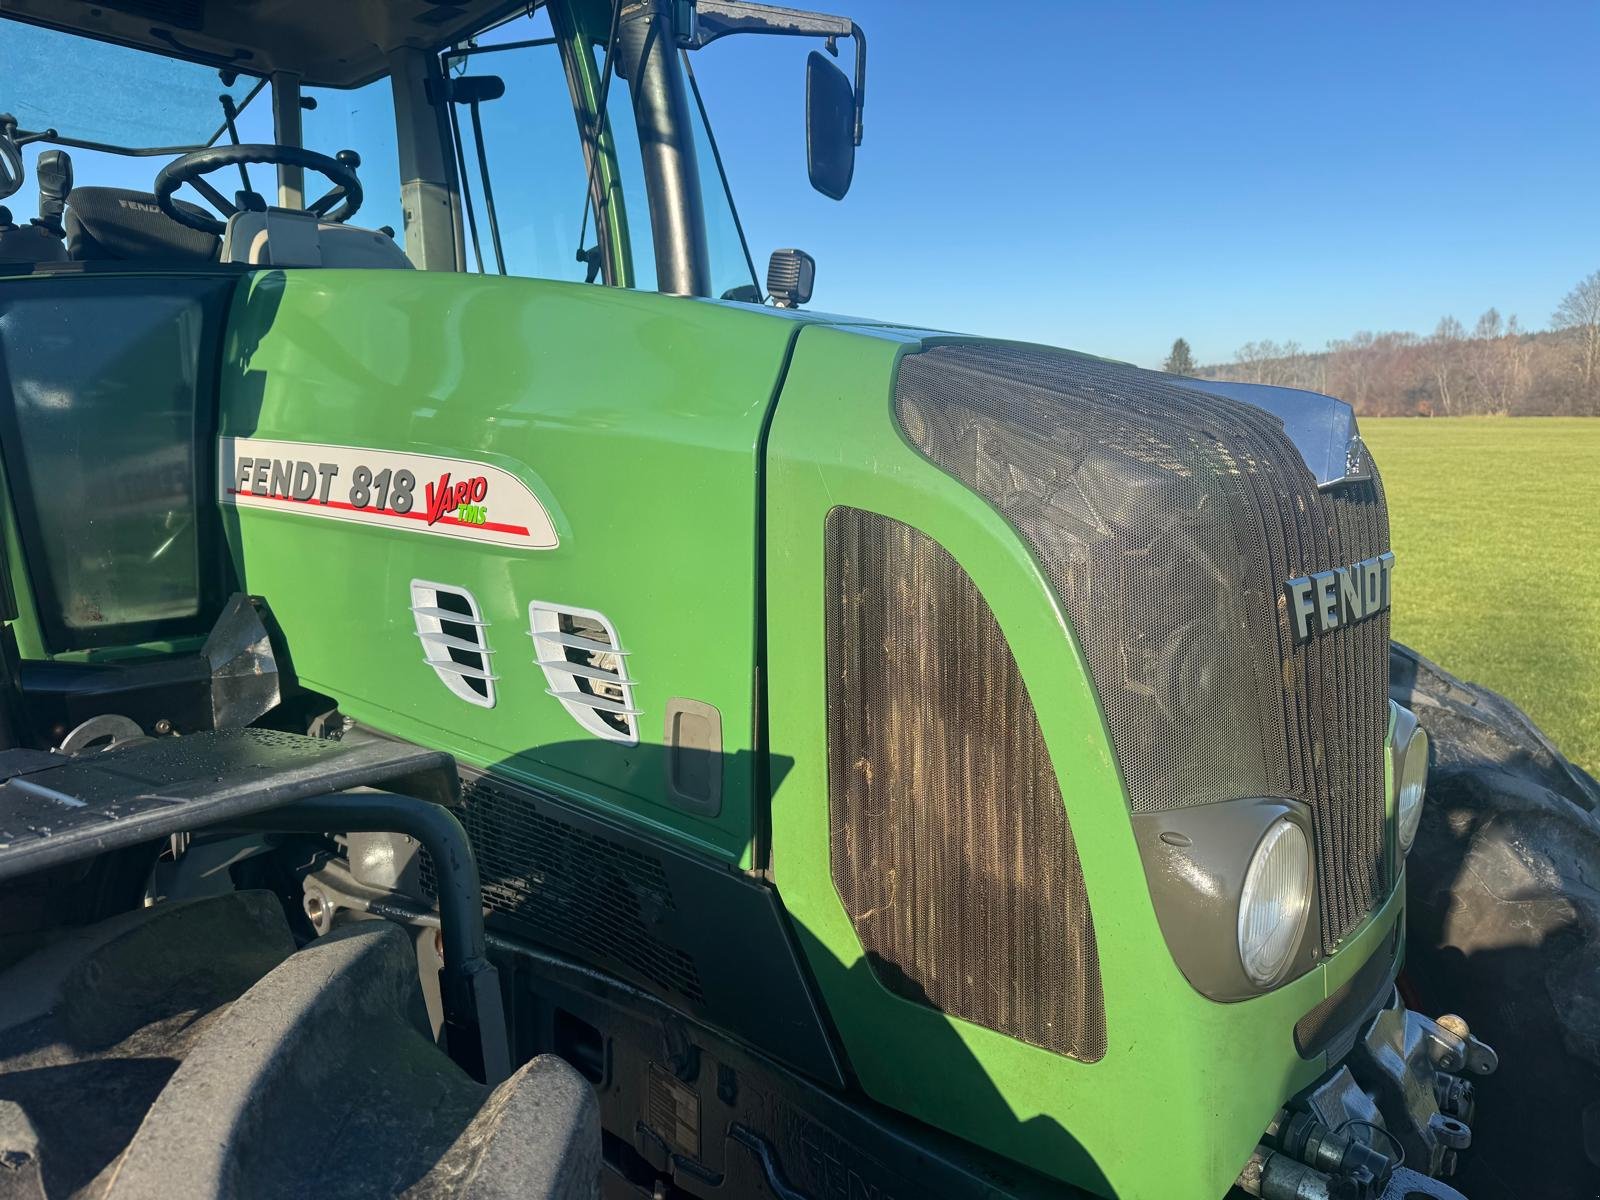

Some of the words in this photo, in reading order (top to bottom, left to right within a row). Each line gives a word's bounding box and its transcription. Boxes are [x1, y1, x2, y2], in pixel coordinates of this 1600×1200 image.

[119, 199, 164, 215] FEND
[235, 457, 338, 504] FENDT
[349, 465, 416, 514] 818
[457, 503, 488, 526] TMS
[1285, 551, 1395, 644] FENDT
